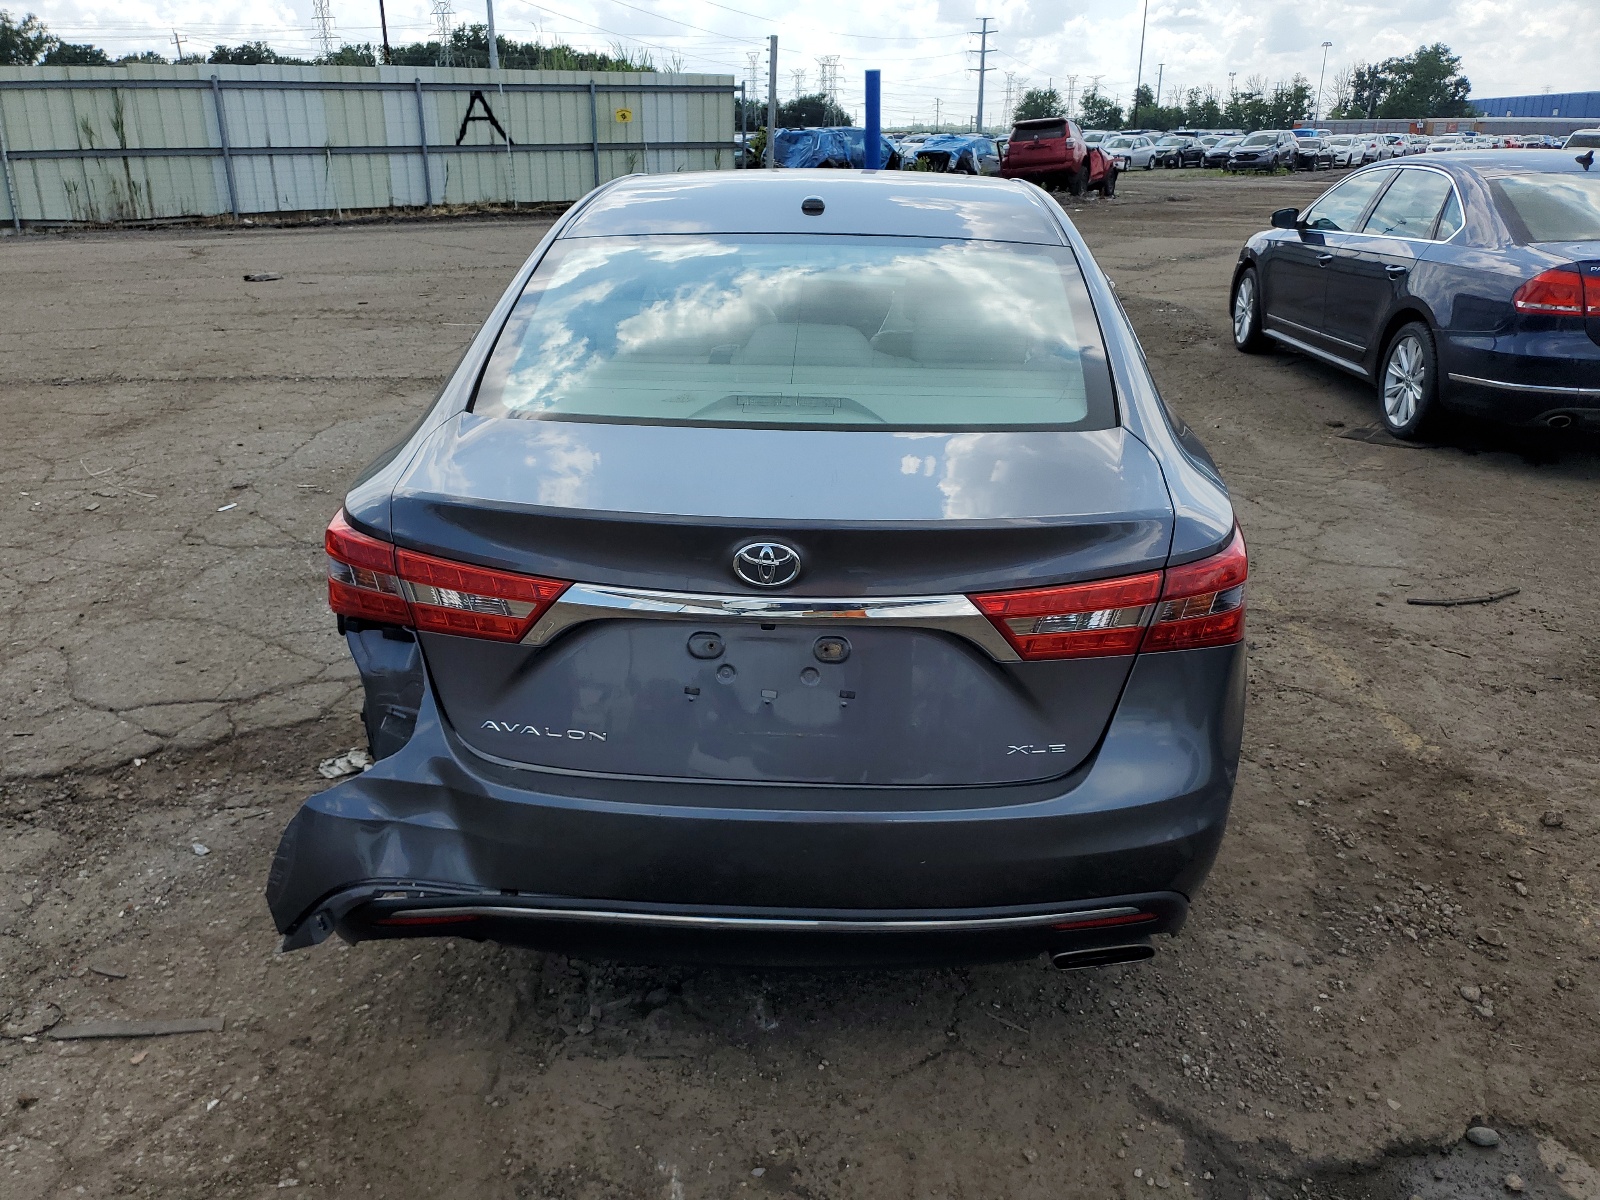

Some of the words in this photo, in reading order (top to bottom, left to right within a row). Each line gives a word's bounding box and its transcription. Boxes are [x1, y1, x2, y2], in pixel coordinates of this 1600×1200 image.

[456, 90, 514, 146] A
[480, 720, 607, 741] AVALON
[1006, 743, 1066, 755] XLE
